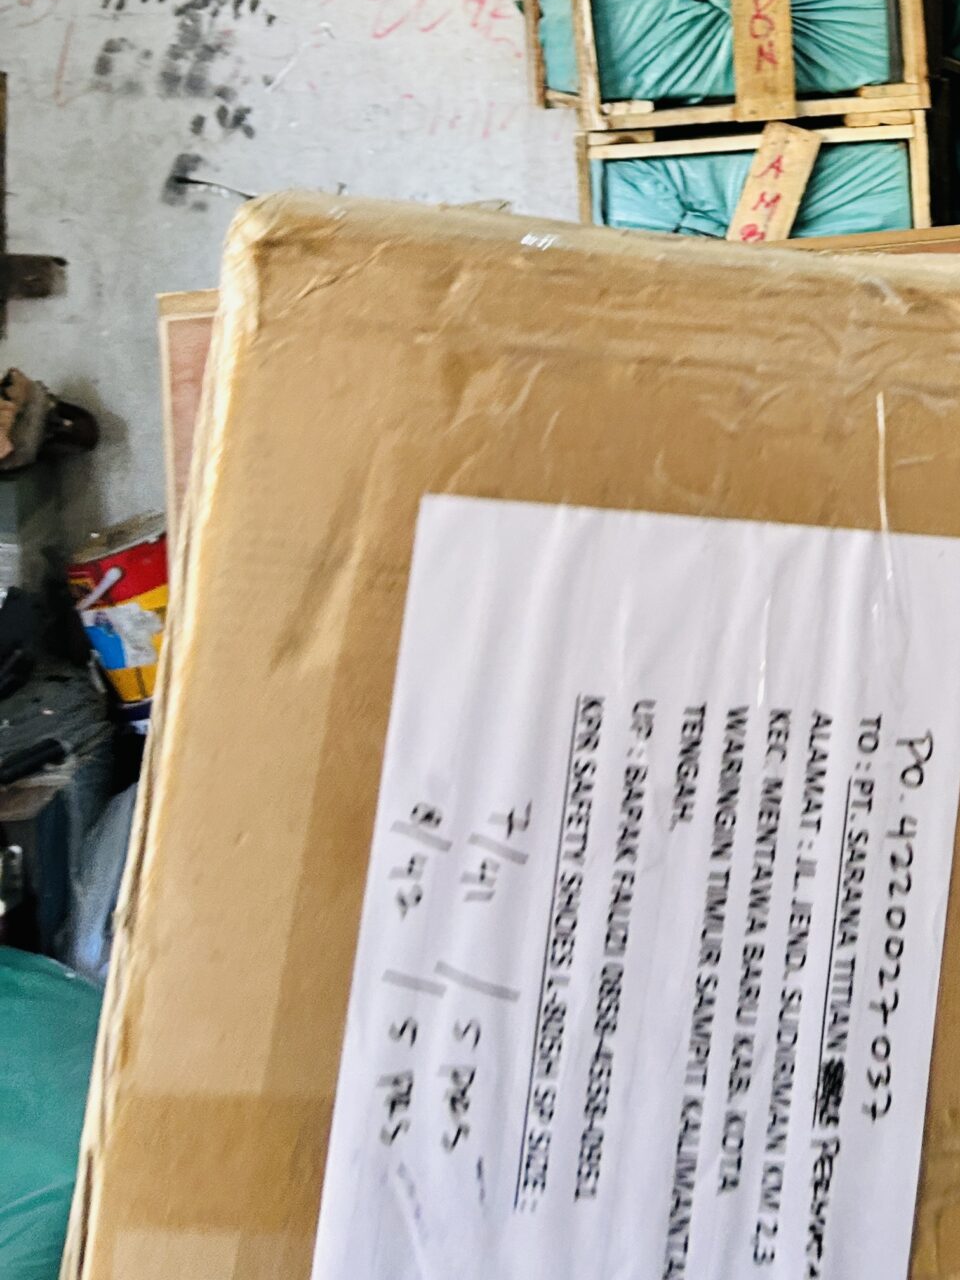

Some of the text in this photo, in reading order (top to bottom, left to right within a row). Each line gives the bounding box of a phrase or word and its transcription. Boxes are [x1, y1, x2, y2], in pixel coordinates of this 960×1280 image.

[562, 758, 598, 866] SAFETY
[614, 764, 649, 865] BAPAK
[800, 710, 834, 834] ALAMAT
[744, 778, 786, 938] MENTAWA
[836, 829, 869, 950] SARANA
[550, 872, 584, 970] SHOES
[604, 869, 636, 958] FAUZI
[662, 704, 750, 1280] WARINGIN TIMUR SAMPIT KALIMANTA
[734, 942, 766, 1026] BARU
[826, 954, 856, 1054] TITIAN
[765, 986, 803, 1155] SUDIRMAN
[716, 1110, 748, 1196] KOTA
